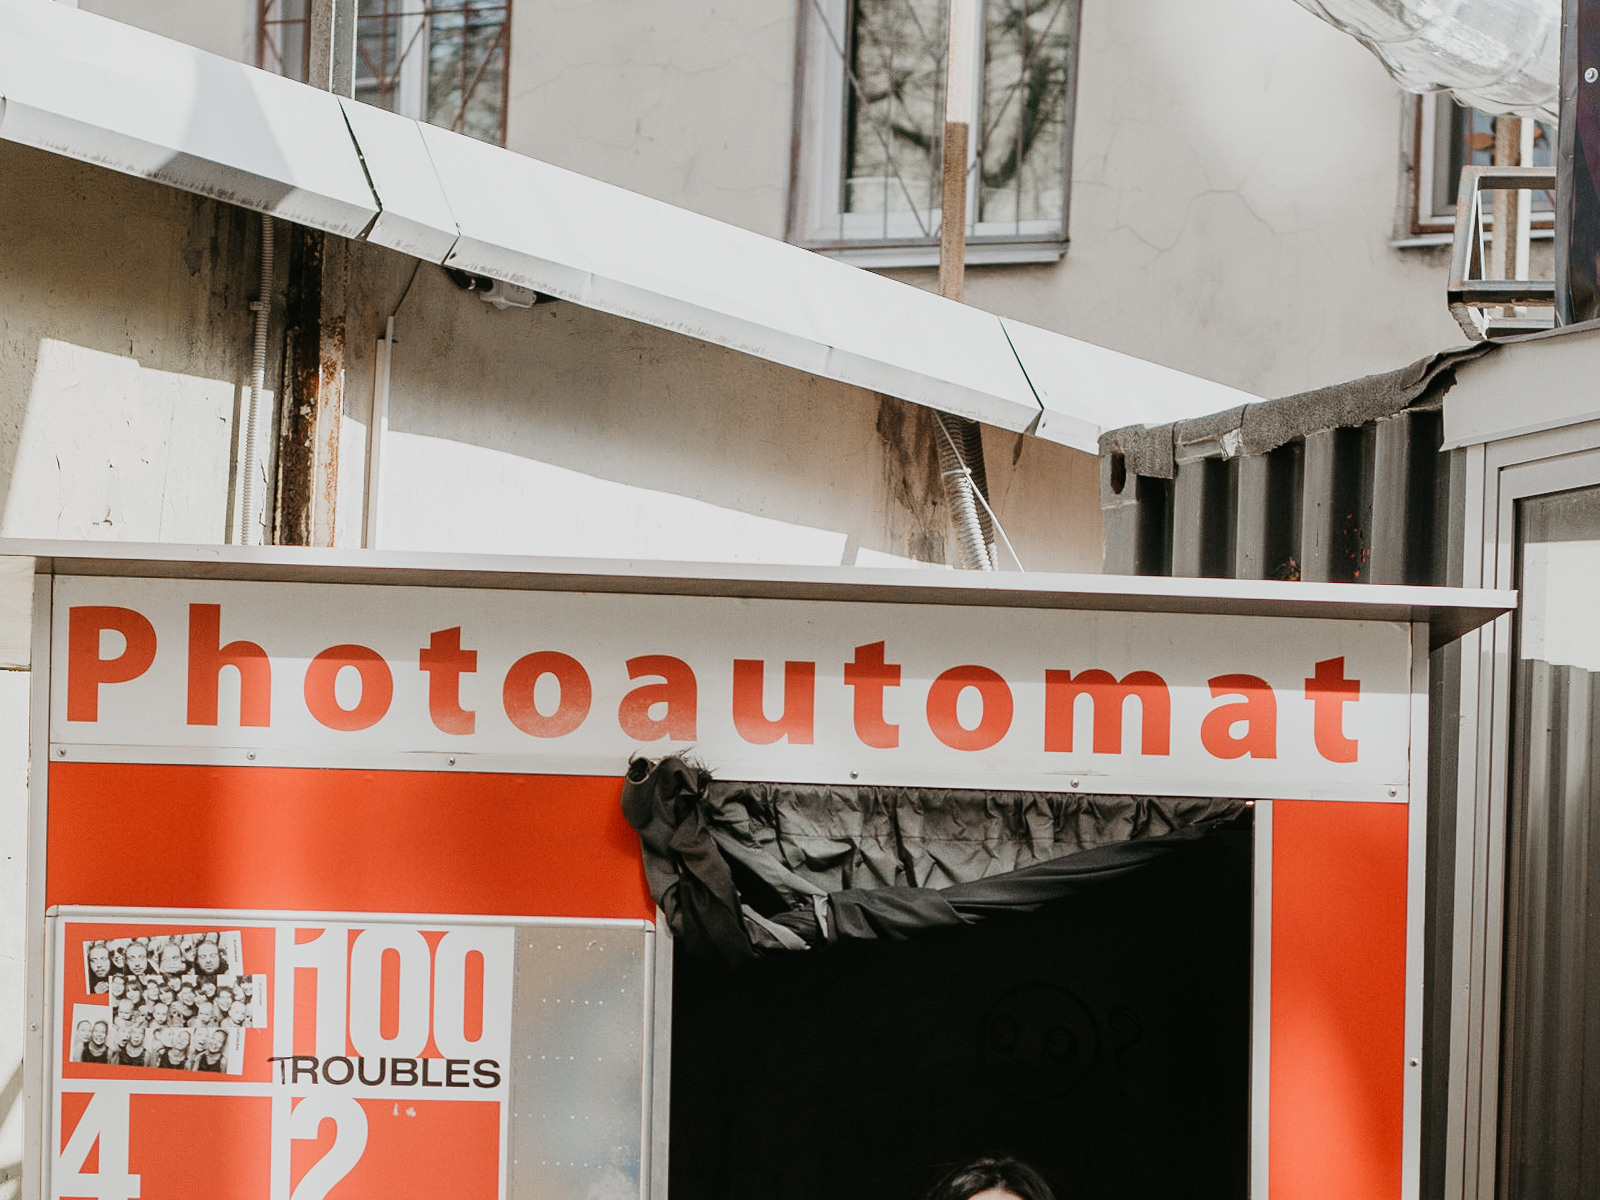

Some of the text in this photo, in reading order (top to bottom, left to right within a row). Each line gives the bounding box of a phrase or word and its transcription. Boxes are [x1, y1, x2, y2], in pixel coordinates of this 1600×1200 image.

[66, 603, 1361, 764] Photoautomat
[290, 926, 512, 1059] 100
[267, 1054, 501, 1089] TROUBLES
